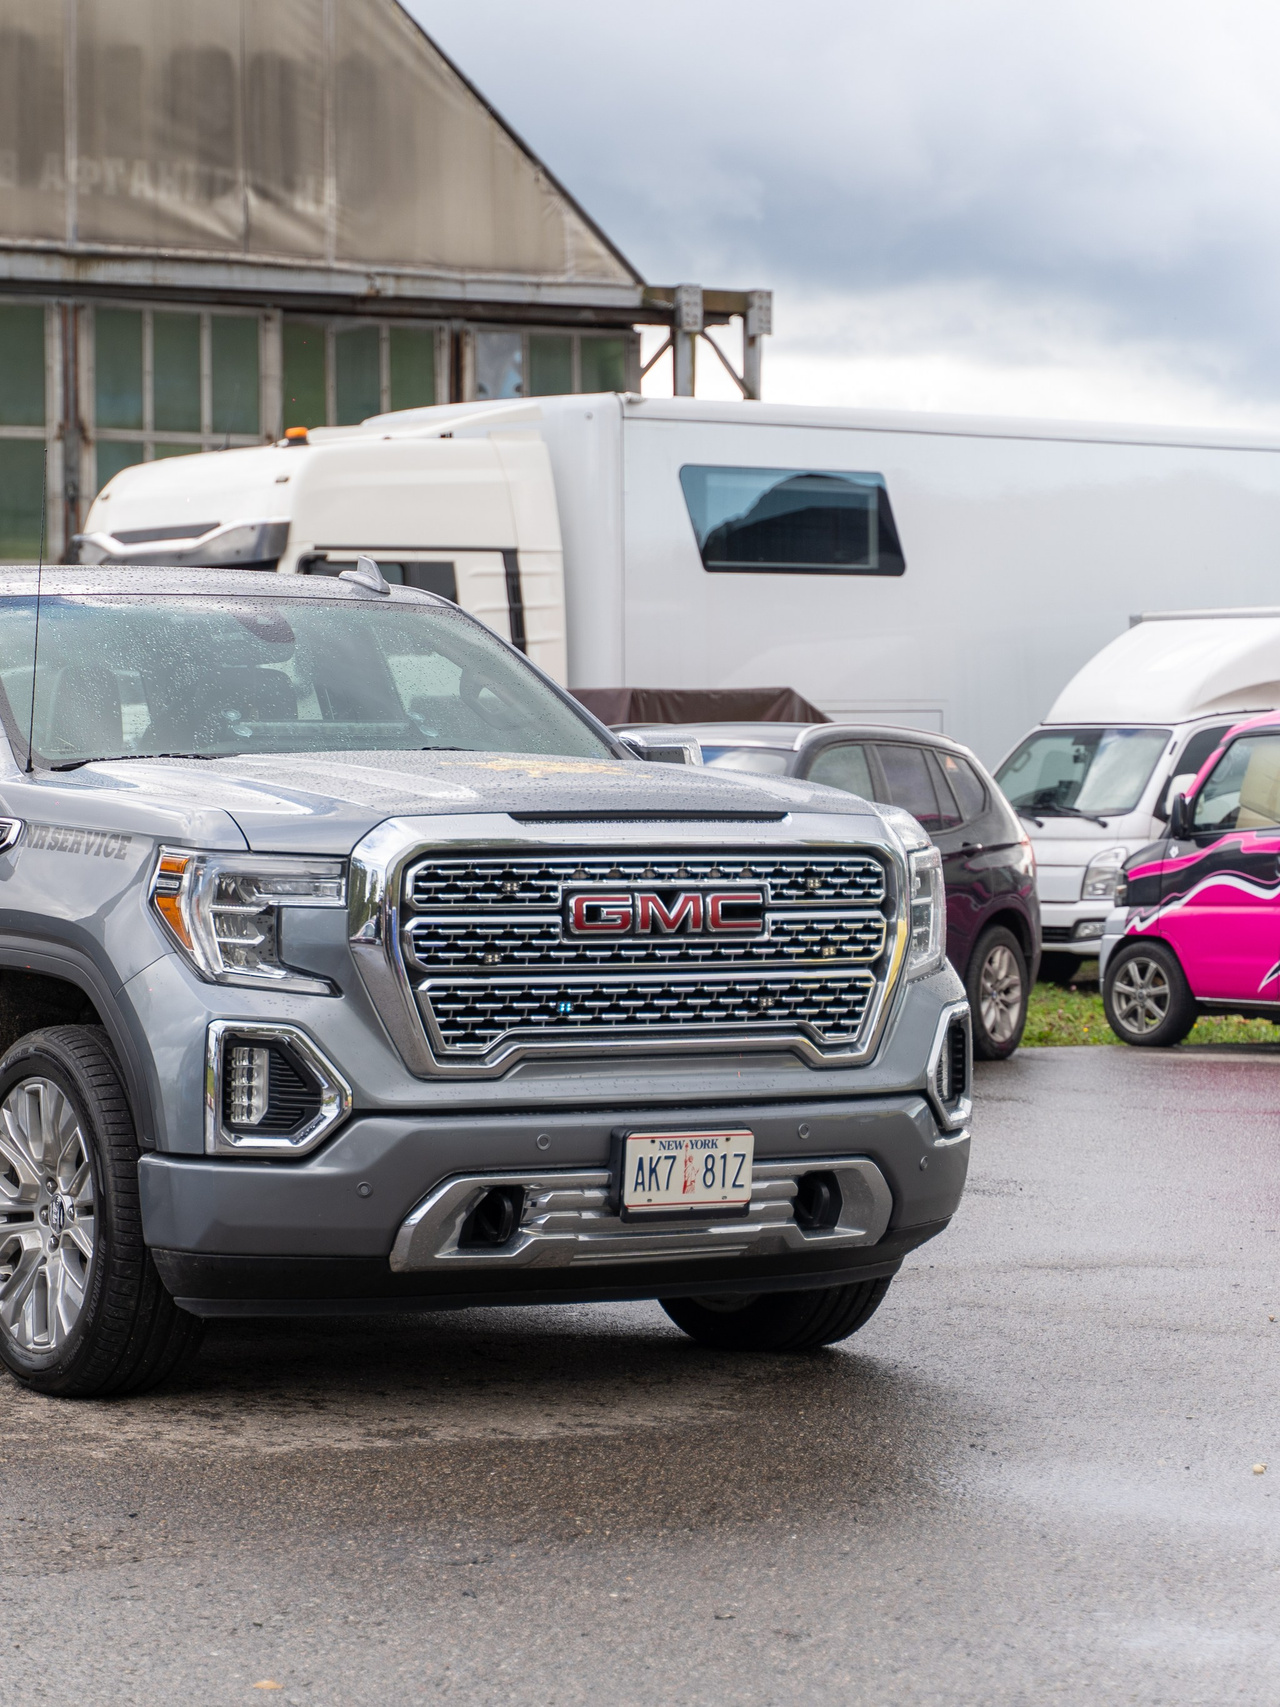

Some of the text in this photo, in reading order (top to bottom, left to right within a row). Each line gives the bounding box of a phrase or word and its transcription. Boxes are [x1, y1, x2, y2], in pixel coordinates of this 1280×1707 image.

[570, 892, 763, 934] GMC
[658, 1138, 718, 1151] NEW YORK
[633, 1152, 747, 1193] AK7 81Z
